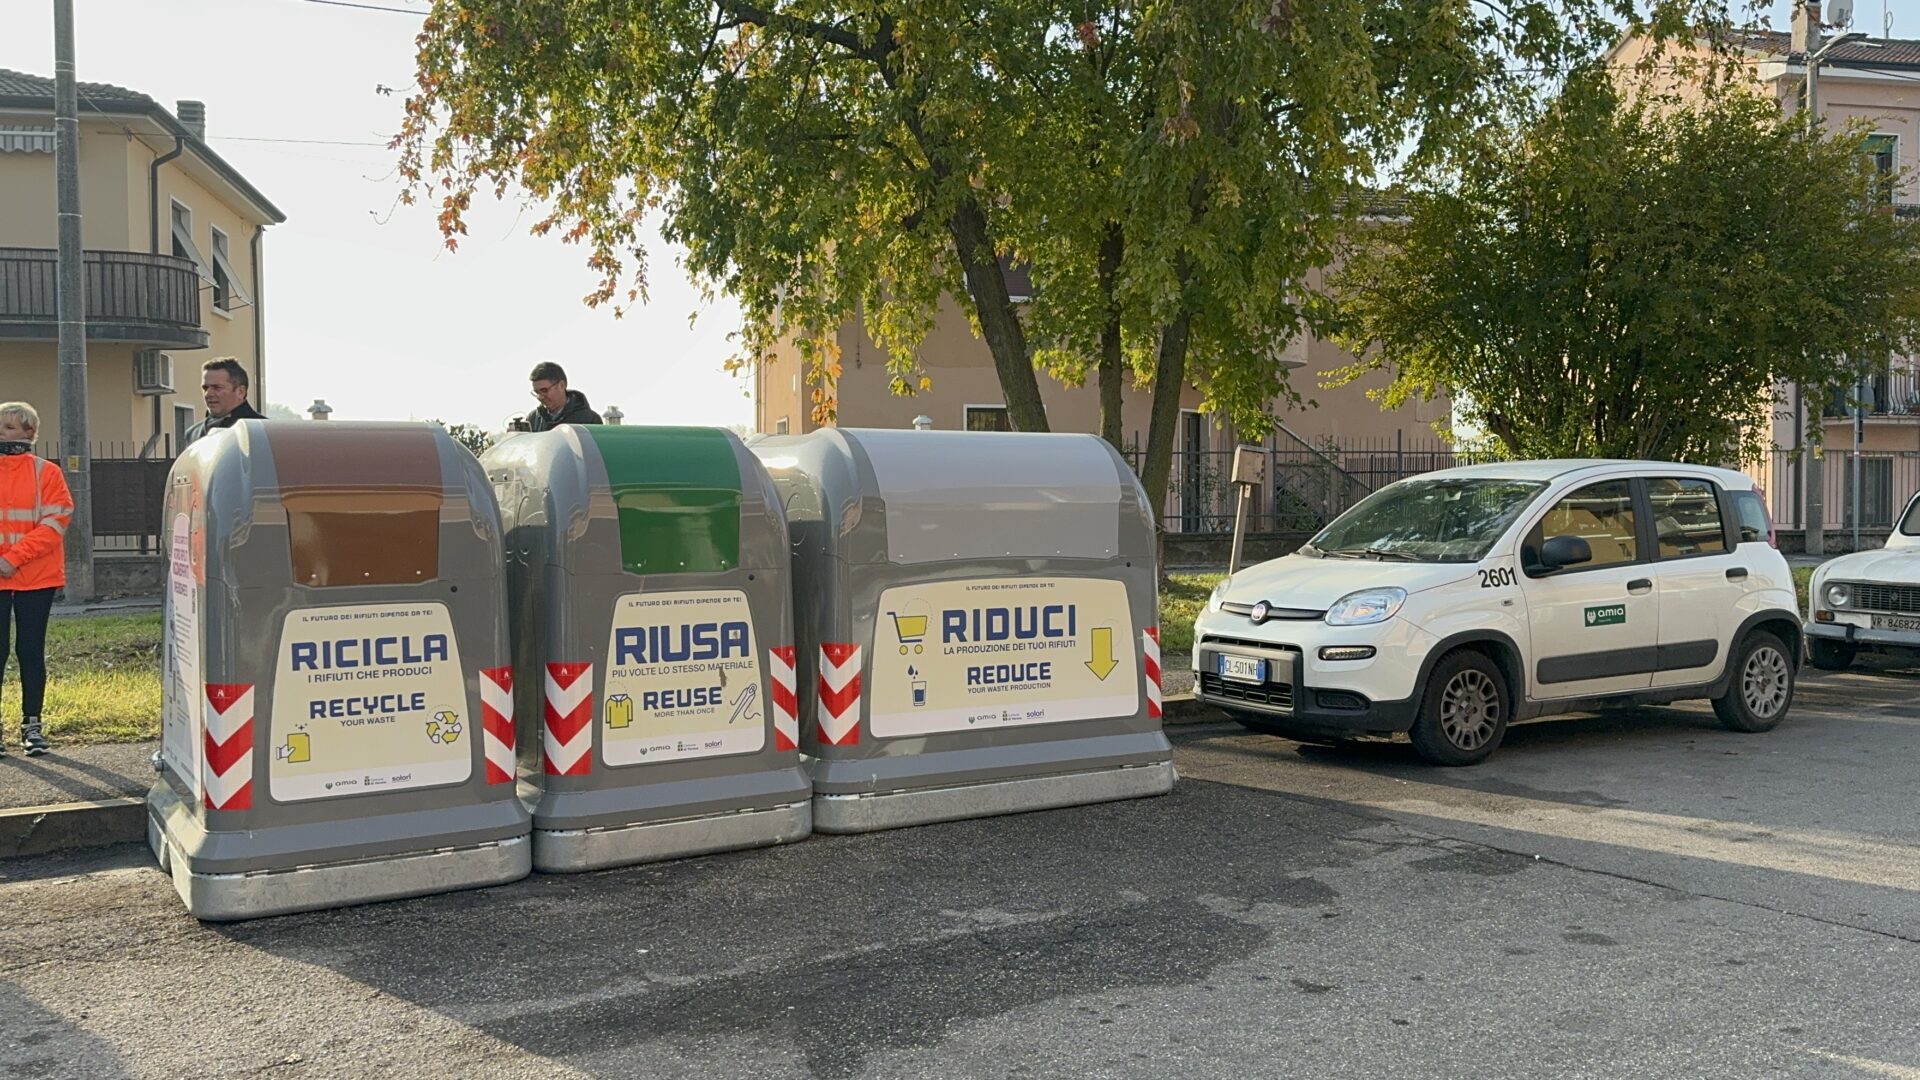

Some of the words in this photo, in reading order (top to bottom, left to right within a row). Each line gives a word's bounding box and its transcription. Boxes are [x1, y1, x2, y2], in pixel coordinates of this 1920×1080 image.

[1478, 567, 1518, 588] 2601
[1597, 607, 1624, 618] amia
[942, 604, 1076, 644] RIDUCI
[1872, 616, 1882, 627] VR
[615, 621, 749, 666] RIUSA
[944, 646, 954, 655] LA
[956, 643, 1011, 654] PRODUZIONE
[1013, 642, 1026, 652] DEI
[1028, 641, 1047, 650] TUOI
[1049, 640, 1076, 649] RIFIUTI
[291, 634, 448, 671] RICICLA
[314, 672, 353, 683] RIFIUTI
[356, 669, 379, 681] CHE
[382, 666, 432, 678] PRODUCI
[629, 666, 656, 677] VOLTE
[659, 665, 670, 675] LO
[672, 663, 706, 674] STESSO
[708, 661, 754, 672] MATERIALE
[967, 661, 1051, 686] REDUCE
[968, 686, 986, 694] YOUR
[987, 685, 1009, 693] WASTE
[1010, 682, 1051, 691] PRODUCTION
[309, 692, 425, 719] RECYCLE
[643, 686, 723, 711] REUSE
[677, 709, 695, 717] THAN
[696, 707, 715, 715] ONCE
[340, 718, 365, 727] YOUR
[366, 716, 396, 725] WASTE
